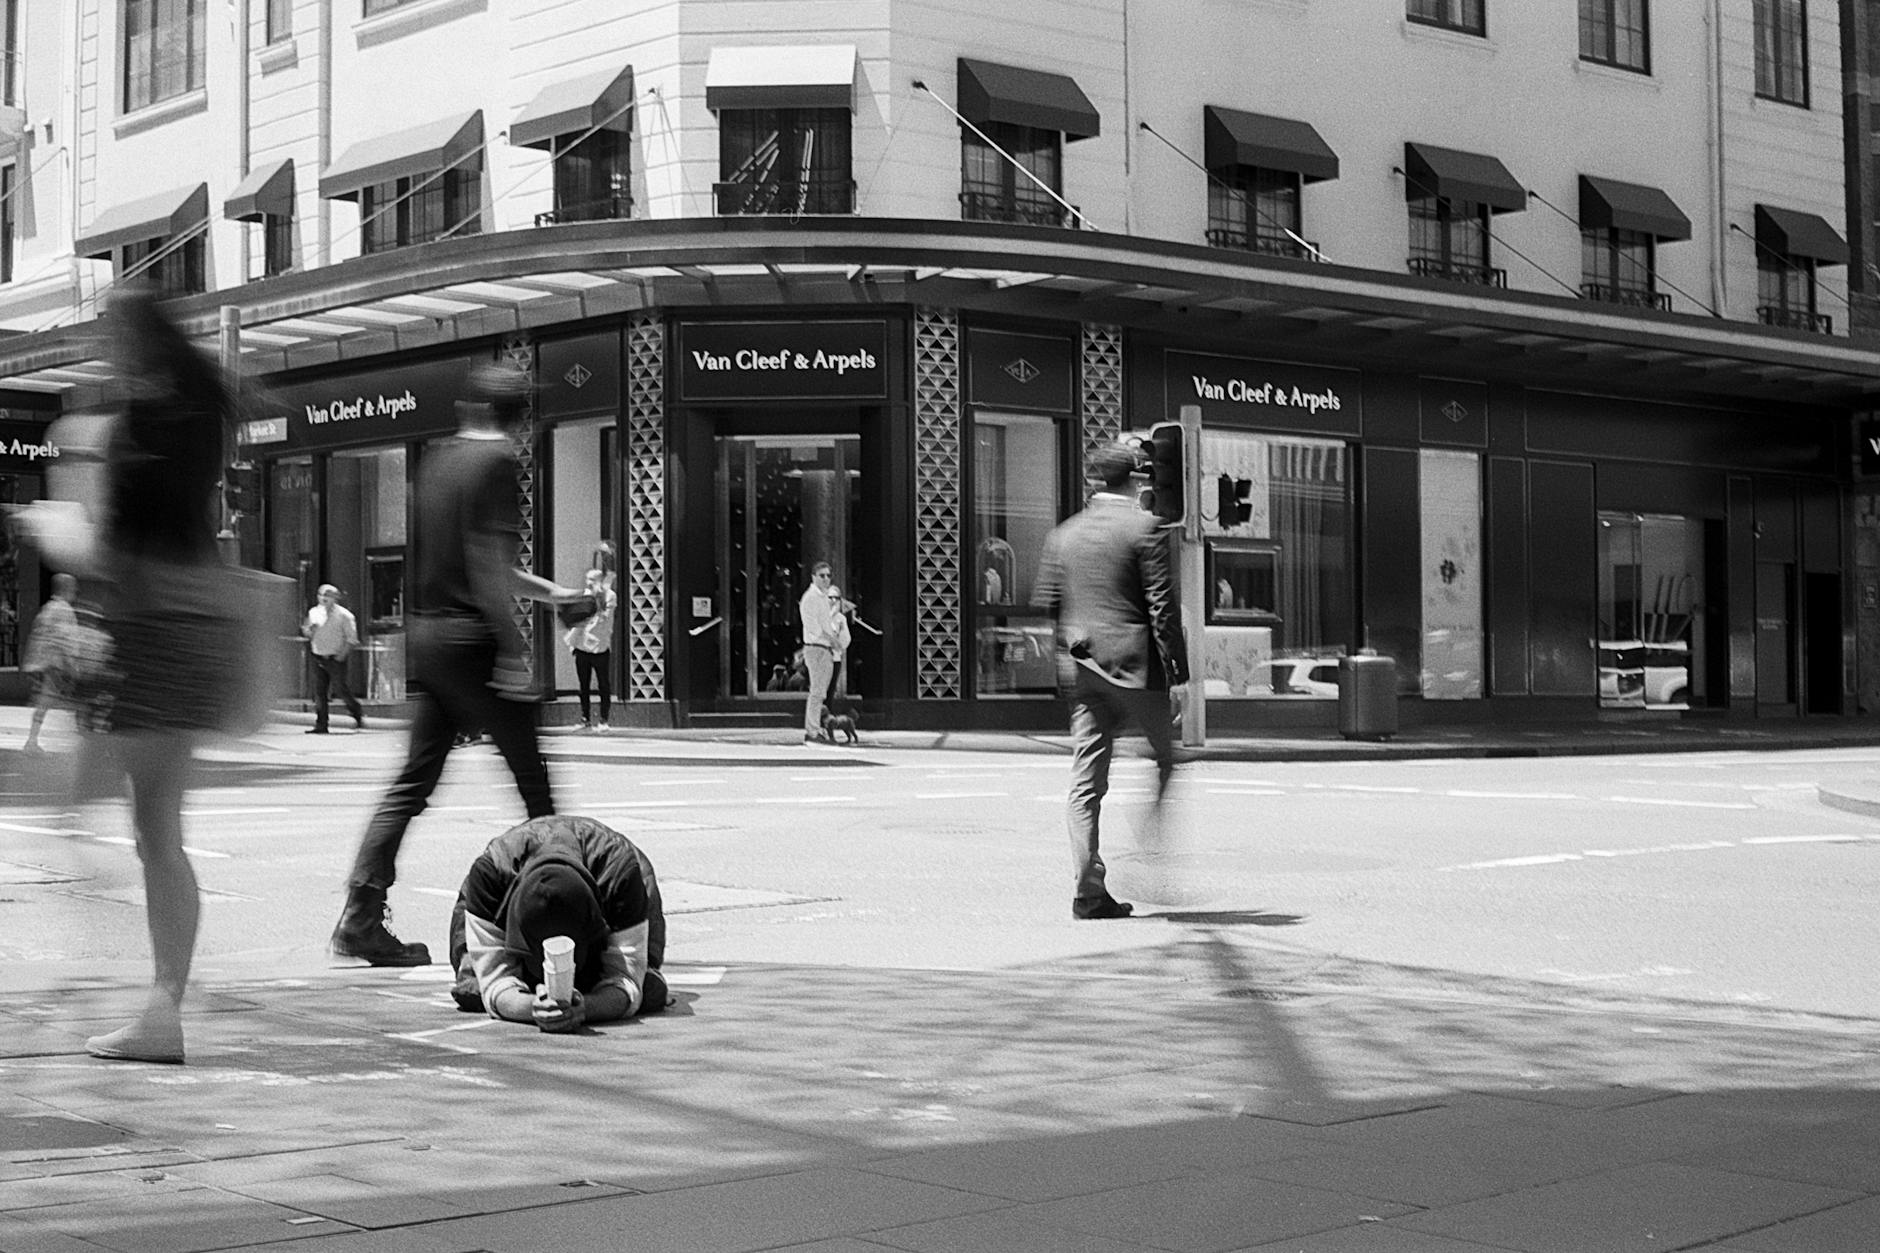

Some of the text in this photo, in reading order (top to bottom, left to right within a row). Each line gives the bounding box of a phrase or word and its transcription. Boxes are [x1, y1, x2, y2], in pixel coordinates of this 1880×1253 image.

[692, 348, 876, 375] Van Cleef & Arpels
[305, 389, 417, 425] Van Cleef & Arpels
[1192, 375, 1341, 415] Van Cleef & Arpels
[9, 438, 61, 461] Arpels
